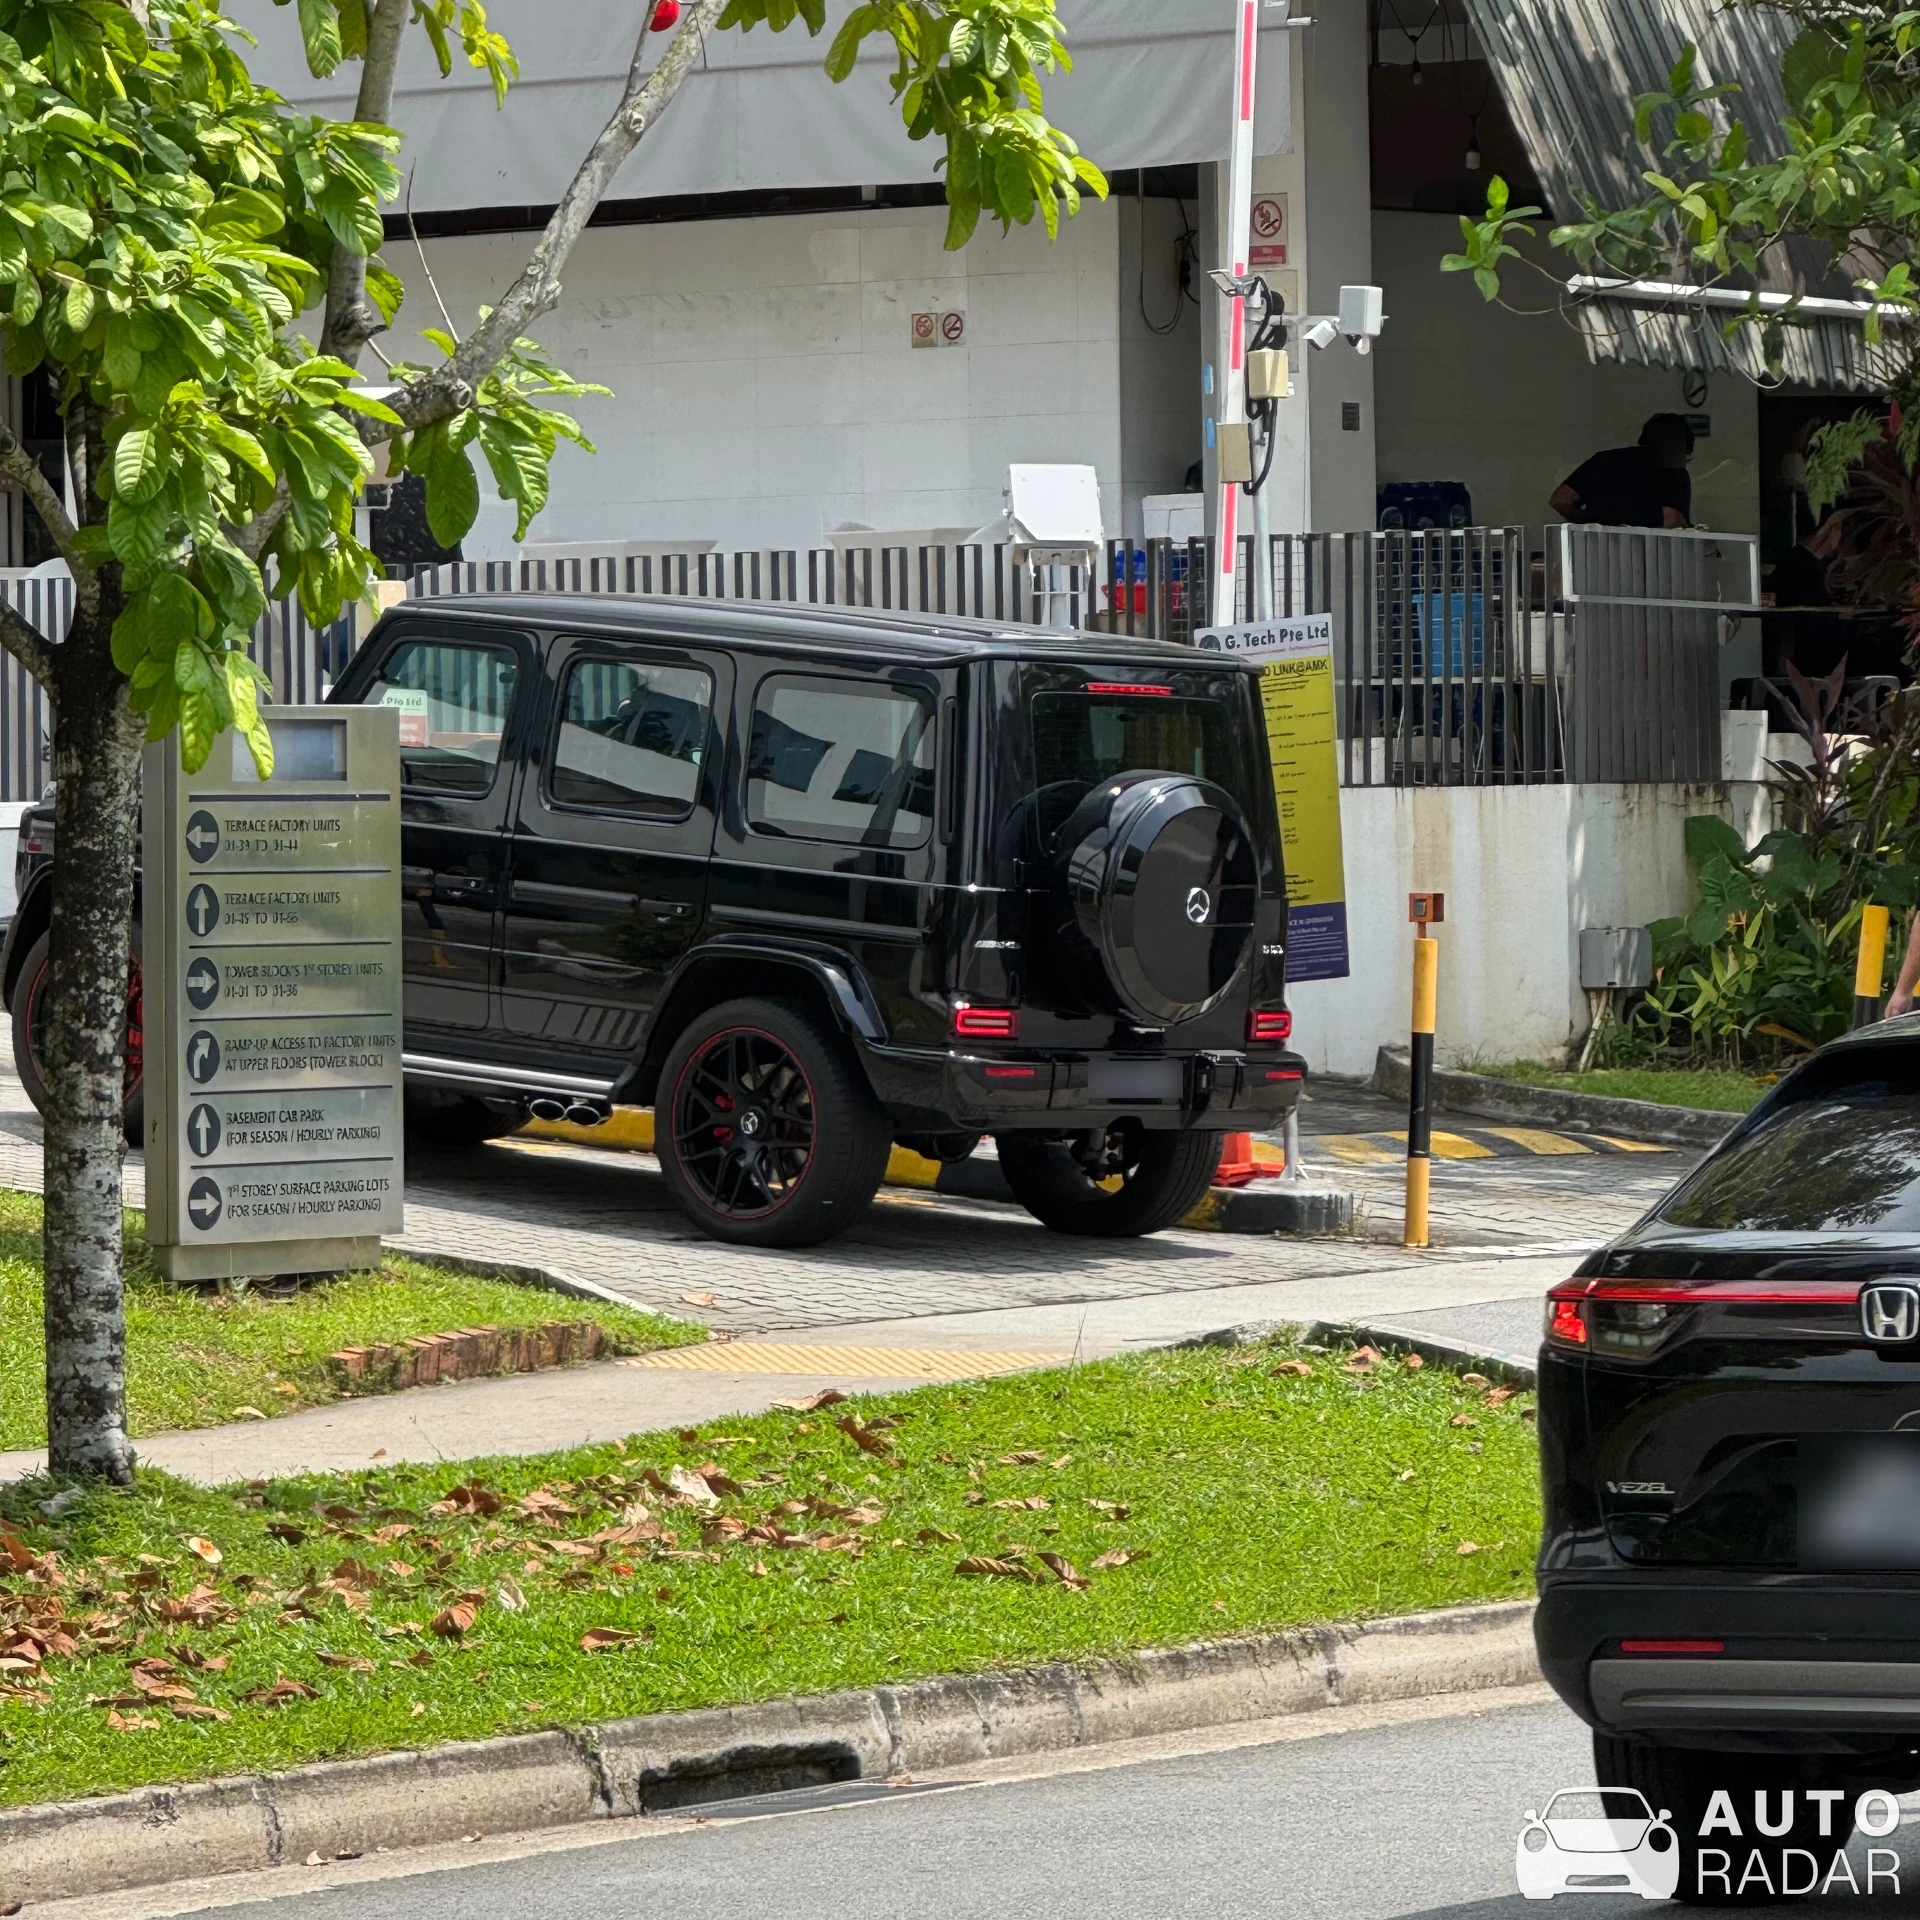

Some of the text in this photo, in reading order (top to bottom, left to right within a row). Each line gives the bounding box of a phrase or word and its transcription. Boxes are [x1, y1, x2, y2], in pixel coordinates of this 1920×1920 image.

[1225, 622, 1329, 649] G. Tech Pte Ltd
[1273, 659, 1328, 676] LINK@AMK
[224, 819, 340, 832] TERRACE FACTORY UNITS
[224, 892, 341, 905] TERRACE FACTORY UNITS
[255, 912, 268, 924] TO
[224, 965, 259, 978] TOWER
[317, 963, 351, 976] STOREY
[356, 963, 383, 975] UNITS
[255, 985, 268, 997] TO
[271, 1037, 306, 1050] ACCESS
[308, 1036, 322, 1049] TO
[324, 1035, 366, 1048] FACTORY
[368, 1034, 396, 1047] UNITS
[225, 1058, 238, 1071] AT
[240, 1058, 268, 1071] UPPER
[271, 1056, 307, 1070] FLOORS
[226, 1109, 324, 1125] BASEMENT CAR PARK
[226, 1131, 248, 1146] (FOR
[250, 1130, 288, 1144] SEASON
[297, 1128, 334, 1142] HOURLY
[337, 1126, 381, 1140] PARKING)
[242, 1183, 278, 1198] STOREY
[280, 1182, 321, 1195] SURFACE
[324, 1180, 364, 1194] PARKING
[366, 1179, 390, 1191] LOTS
[227, 1204, 250, 1219] (FOR
[252, 1202, 290, 1216] SEASON
[298, 1200, 336, 1214] HOURLY
[338, 1198, 381, 1212] PARKING)
[1606, 1481, 1676, 1494] VEZEL
